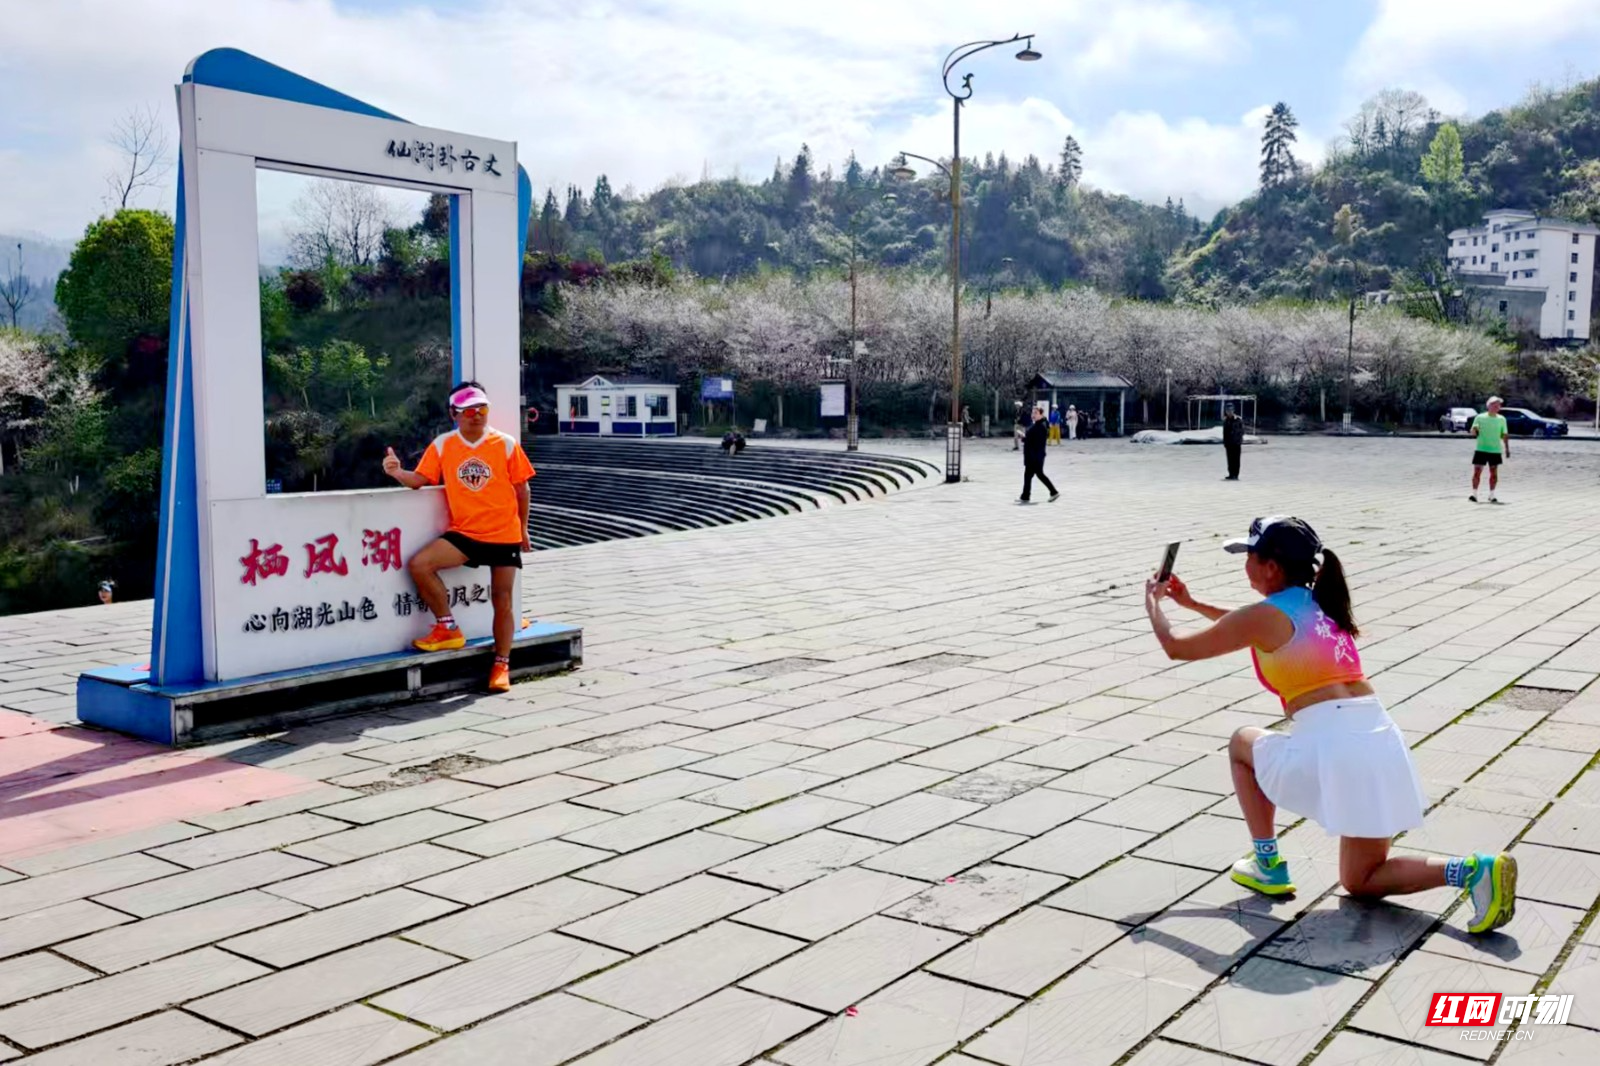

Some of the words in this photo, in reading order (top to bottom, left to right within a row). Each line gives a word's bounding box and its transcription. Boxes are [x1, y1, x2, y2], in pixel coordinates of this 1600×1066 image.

[239, 526, 403, 586] 栖凤湖
[243, 597, 378, 633] 心向湖光山色
